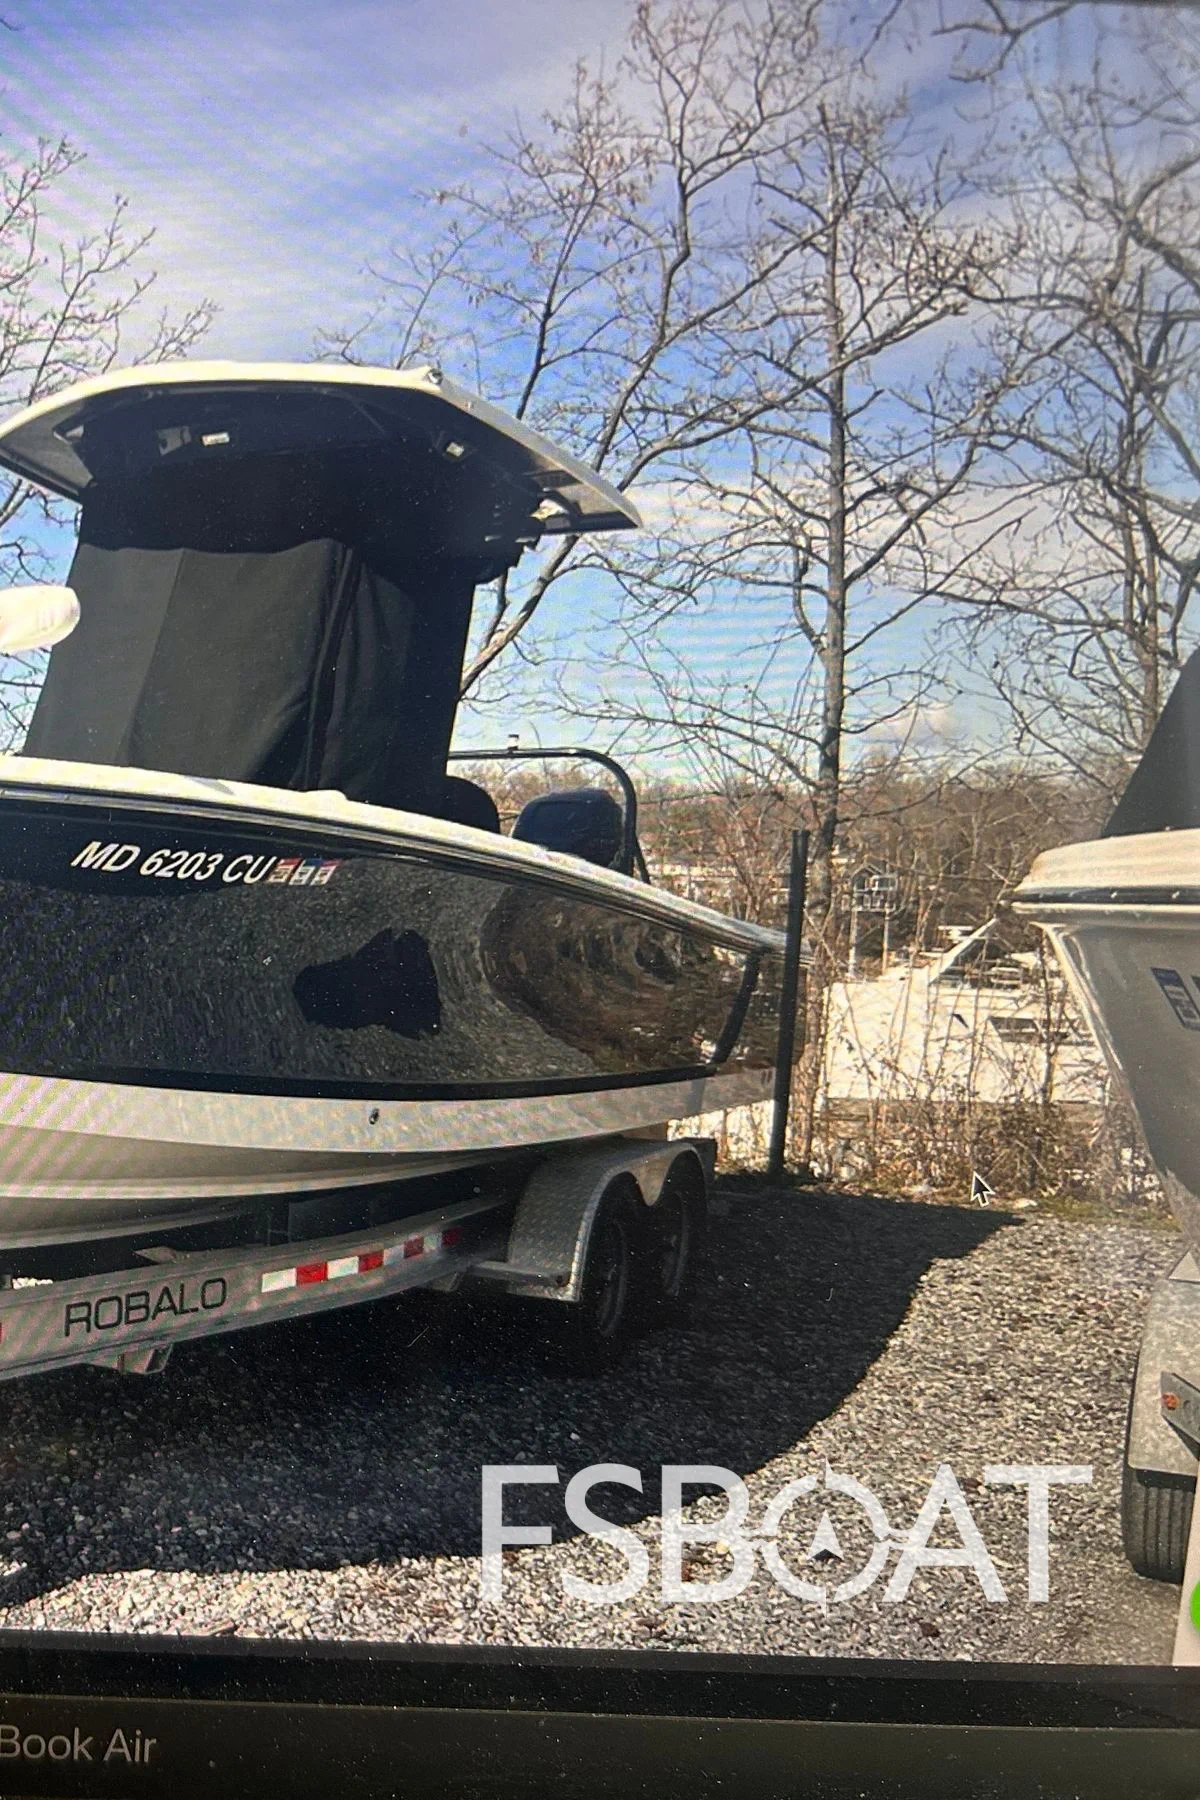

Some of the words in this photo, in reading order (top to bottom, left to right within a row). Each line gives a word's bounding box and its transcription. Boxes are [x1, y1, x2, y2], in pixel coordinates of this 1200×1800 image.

[70, 840, 141, 873] MD
[139, 848, 225, 881] 6203
[221, 855, 278, 884] CU
[64, 1277, 228, 1338] ROBALO
[103, 1728, 156, 1763] Air
